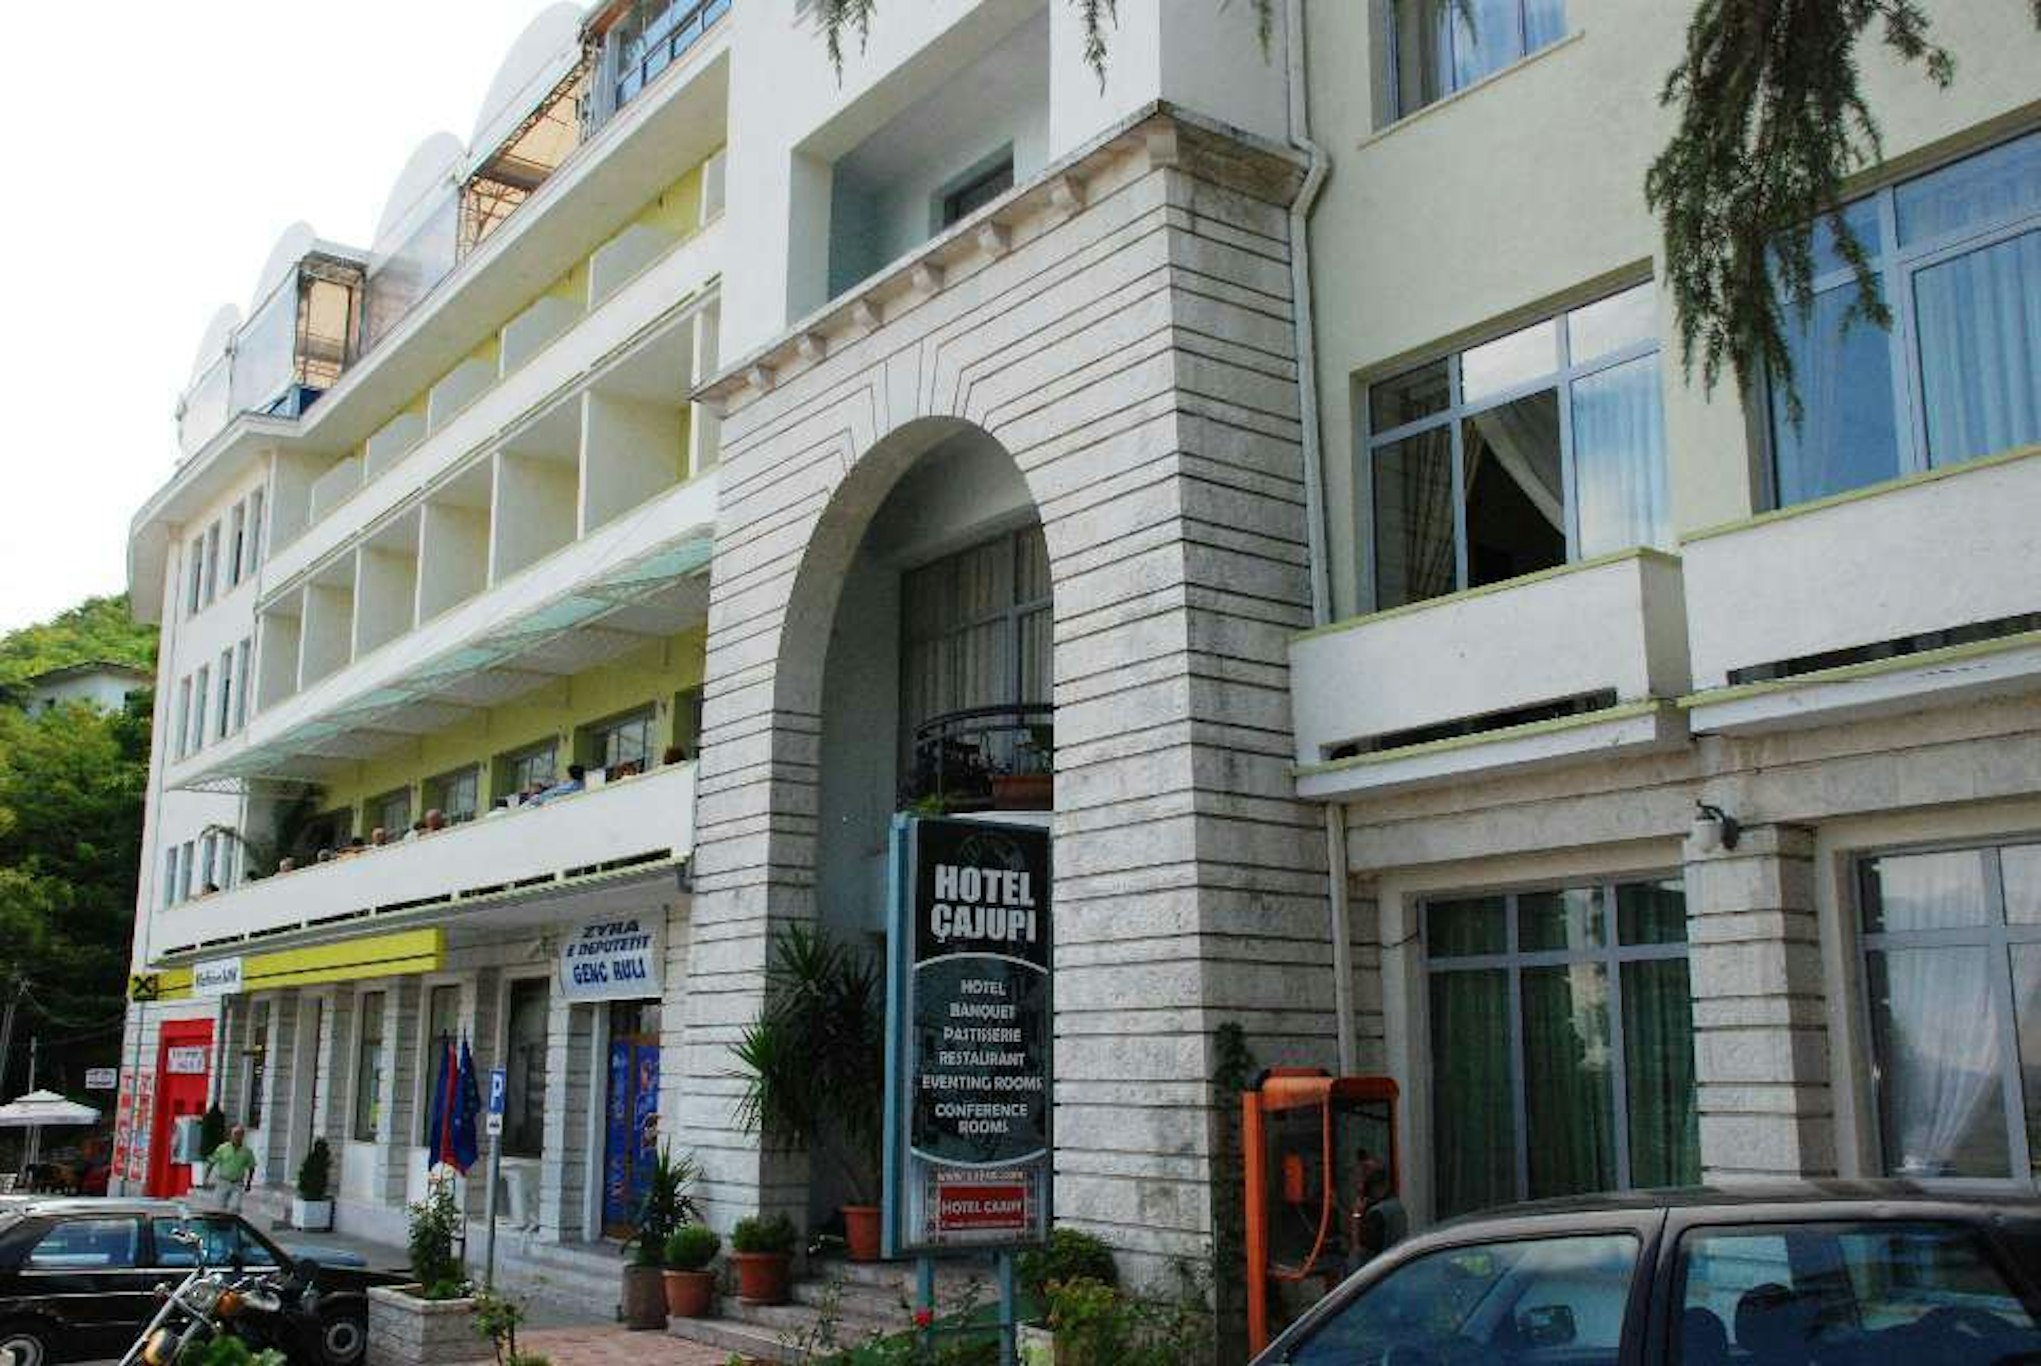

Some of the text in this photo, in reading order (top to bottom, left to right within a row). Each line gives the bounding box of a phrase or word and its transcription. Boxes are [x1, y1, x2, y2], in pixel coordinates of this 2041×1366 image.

[935, 864, 1034, 906] HOTEL
[930, 903, 1036, 943] ÇAJUPI
[961, 979, 1007, 996] HOTEL
[949, 1002, 1016, 1020] BANQUET
[939, 1050, 1026, 1067] RESTAURANT
[491, 1073, 503, 1108] P
[922, 1074, 992, 1090] EVENTING
[935, 1103, 1029, 1118] CONFERENCE
